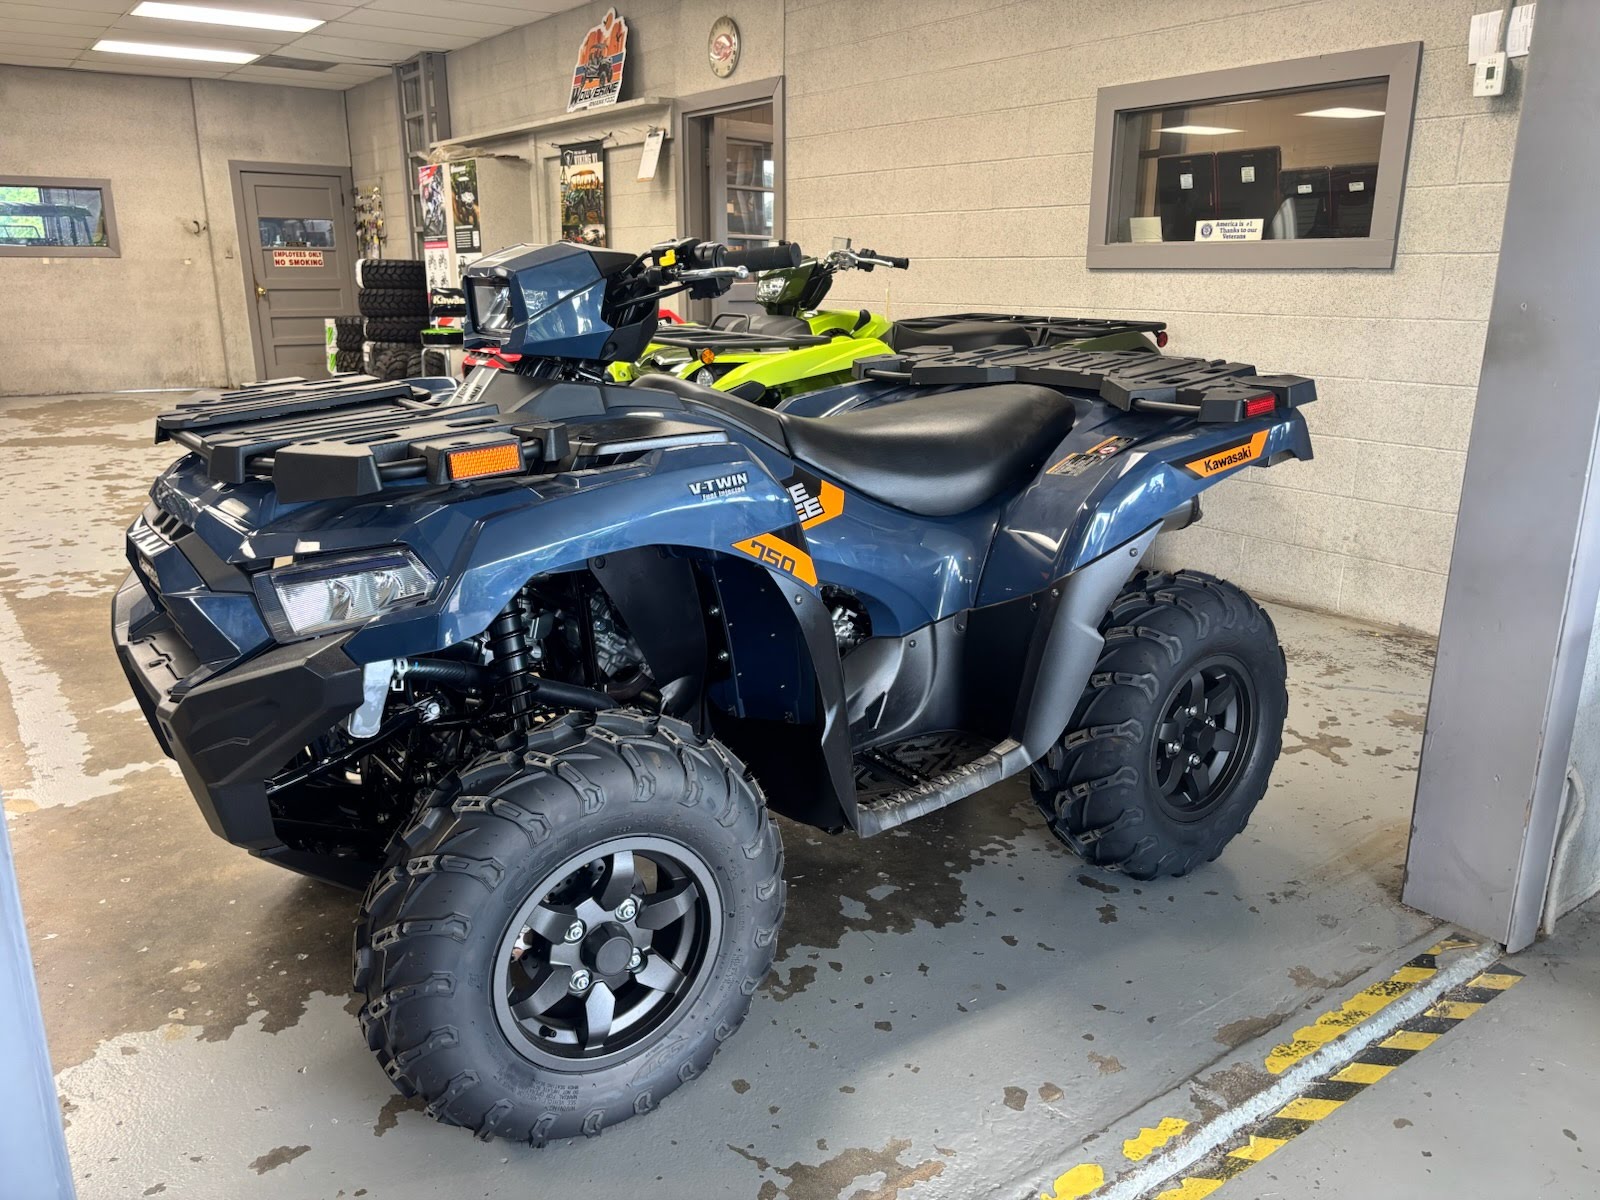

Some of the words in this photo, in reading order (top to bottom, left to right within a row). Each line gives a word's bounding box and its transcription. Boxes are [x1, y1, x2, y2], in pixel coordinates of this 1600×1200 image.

[433, 295, 466, 305] Kawas
[1204, 446, 1252, 473] Kawasaki
[689, 472, 748, 495] V-TWIN
[750, 539, 796, 575] 750
